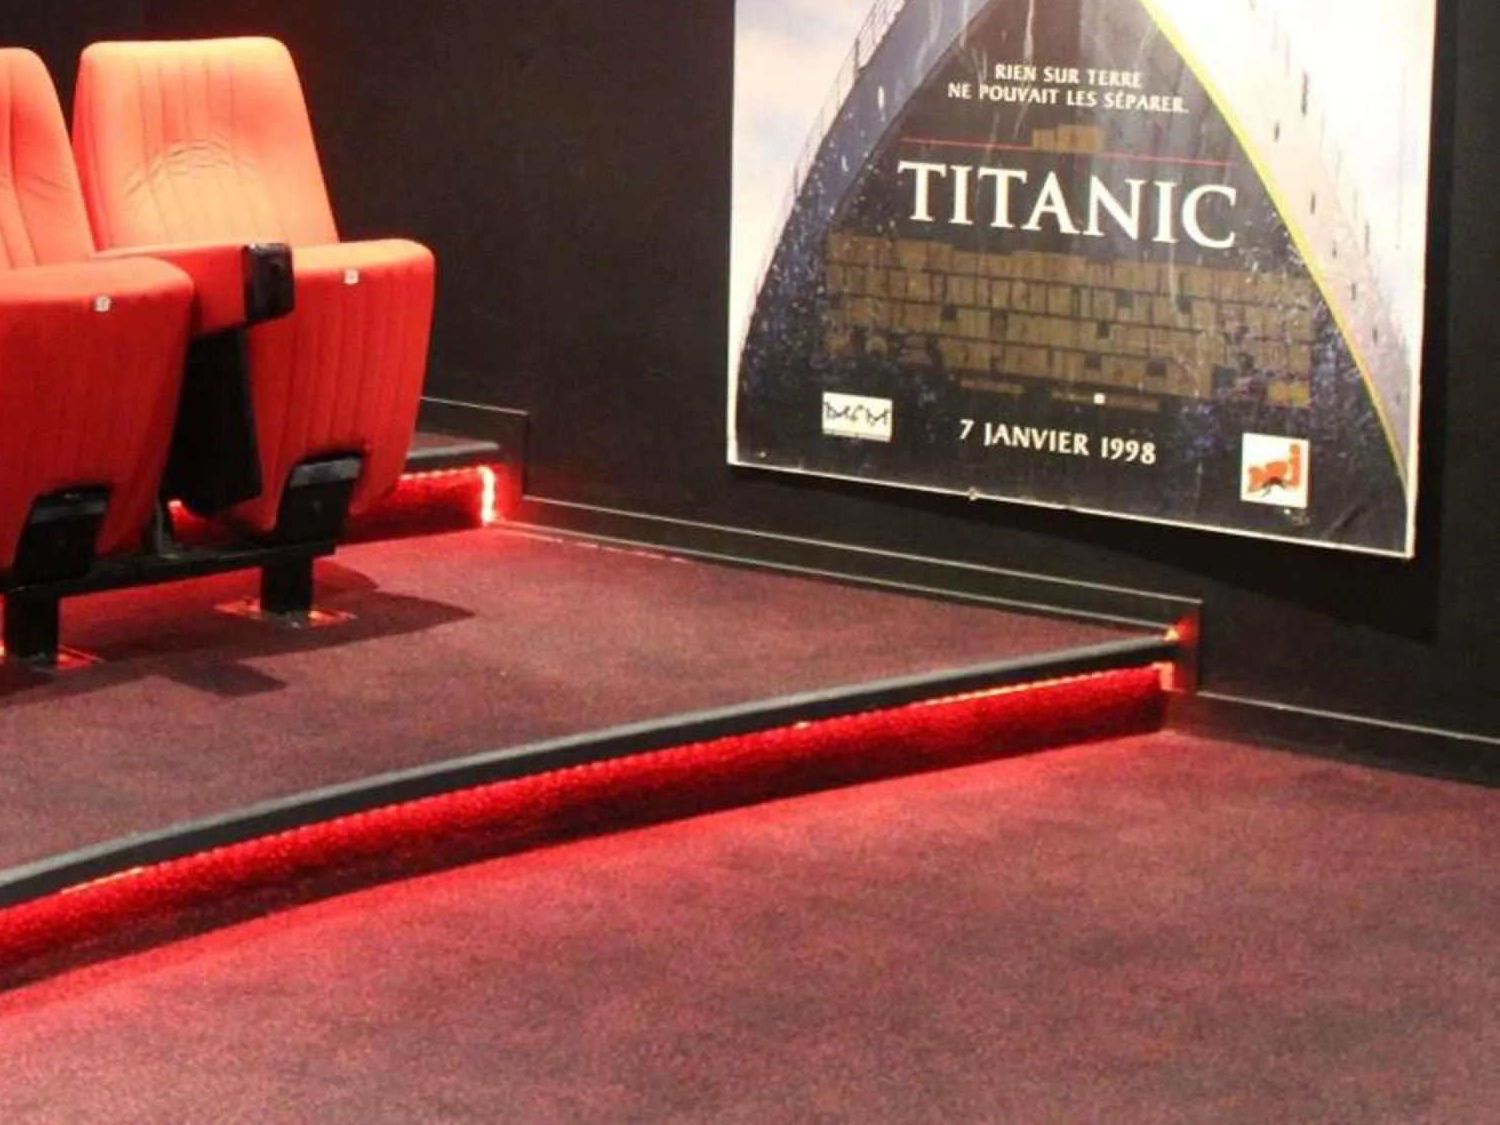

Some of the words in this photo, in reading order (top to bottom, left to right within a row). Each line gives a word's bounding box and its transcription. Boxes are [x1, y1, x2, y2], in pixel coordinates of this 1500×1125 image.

[995, 64, 1037, 82] RIEN
[1043, 66, 1080, 84] SUR
[1087, 69, 1143, 88] TERRE
[947, 83, 972, 99] NE
[979, 84, 1060, 104] POUVAIT
[1066, 91, 1098, 107] LES
[897, 160, 1237, 249] TITANIC
[959, 418, 975, 440] 7
[984, 422, 1090, 456] JANVIER
[1100, 436, 1157, 465] 1998
